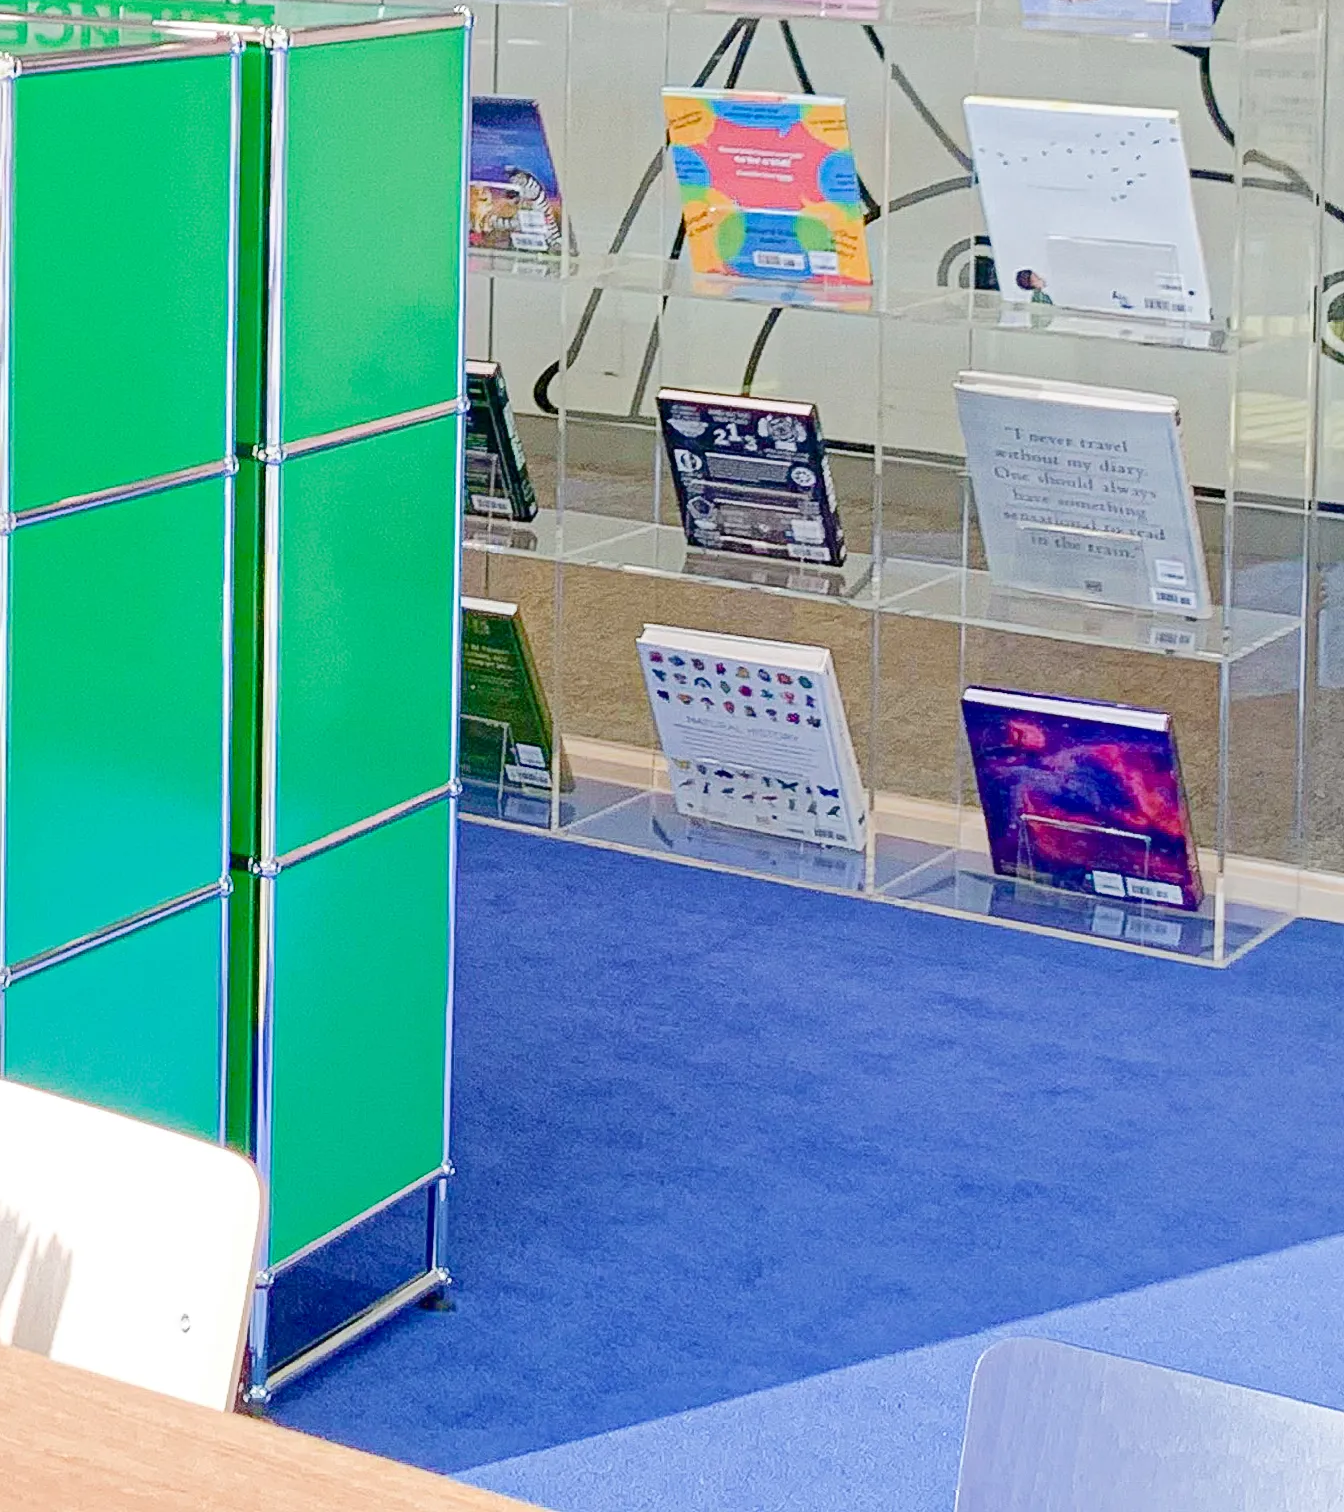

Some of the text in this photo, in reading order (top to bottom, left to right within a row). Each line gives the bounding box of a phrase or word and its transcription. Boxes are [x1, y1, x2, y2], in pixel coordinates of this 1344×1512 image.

[1028, 431, 1073, 448] never
[1079, 439, 1128, 453] travel
[994, 448, 1059, 466] without
[1066, 459, 1093, 472] my
[993, 465, 1157, 504] One should always
[1012, 488, 1149, 522] have something
[1030, 534, 1049, 546] in
[1053, 535, 1081, 551] the
[1129, 527, 1166, 541] read
